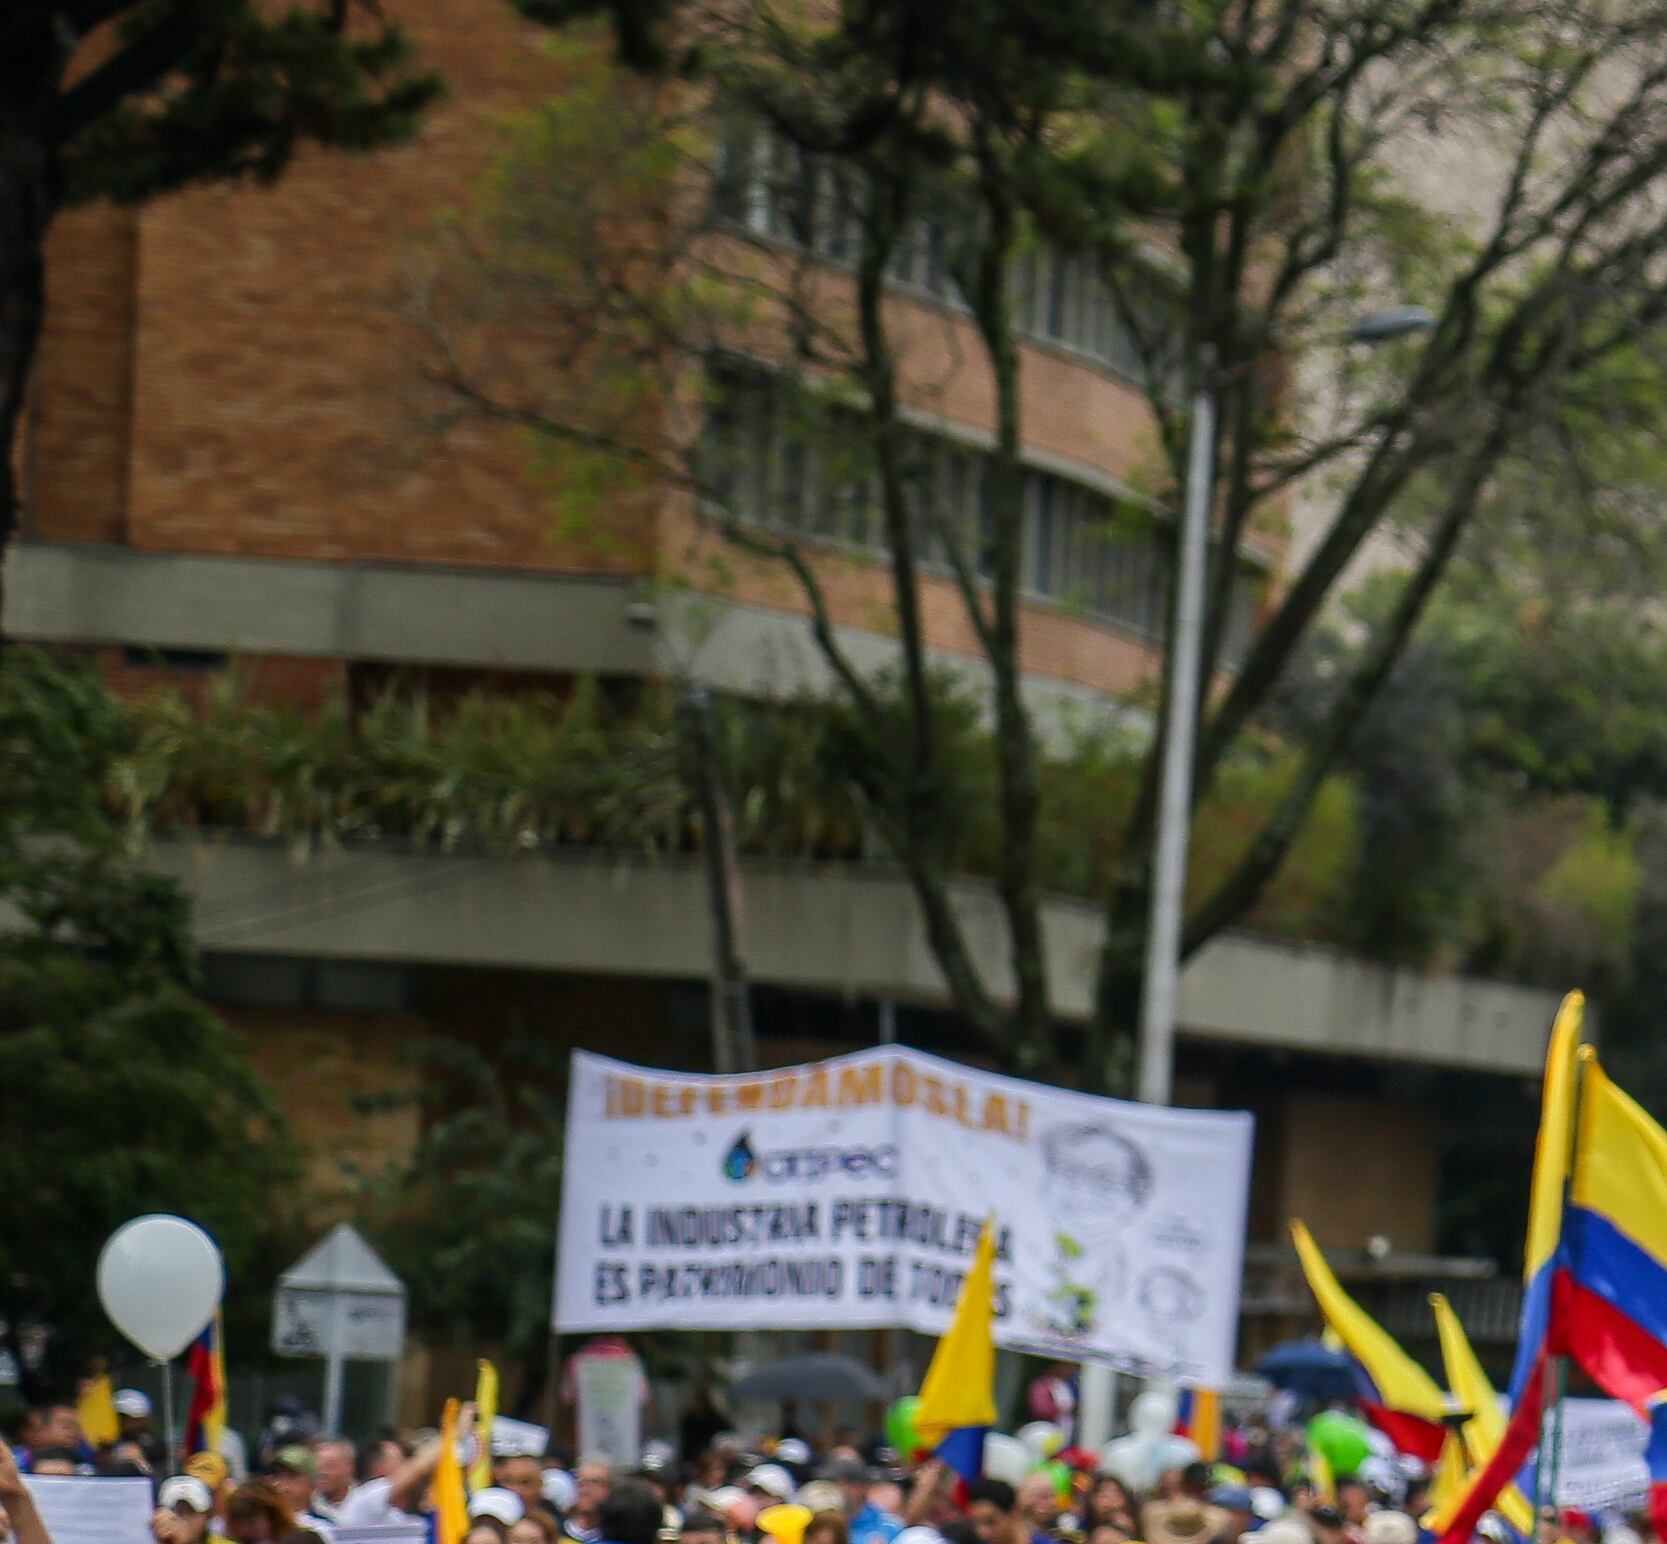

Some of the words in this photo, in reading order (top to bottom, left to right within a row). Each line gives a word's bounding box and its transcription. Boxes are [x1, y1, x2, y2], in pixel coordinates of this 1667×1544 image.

[600, 1203, 632, 1245] LA
[646, 1201, 819, 1246] INDUSTRIA
[595, 1262, 631, 1303] ES
[640, 1260, 843, 1299] PATRIMONIO
[857, 1255, 897, 1298] DE
[911, 1261, 1012, 1317] TODS
